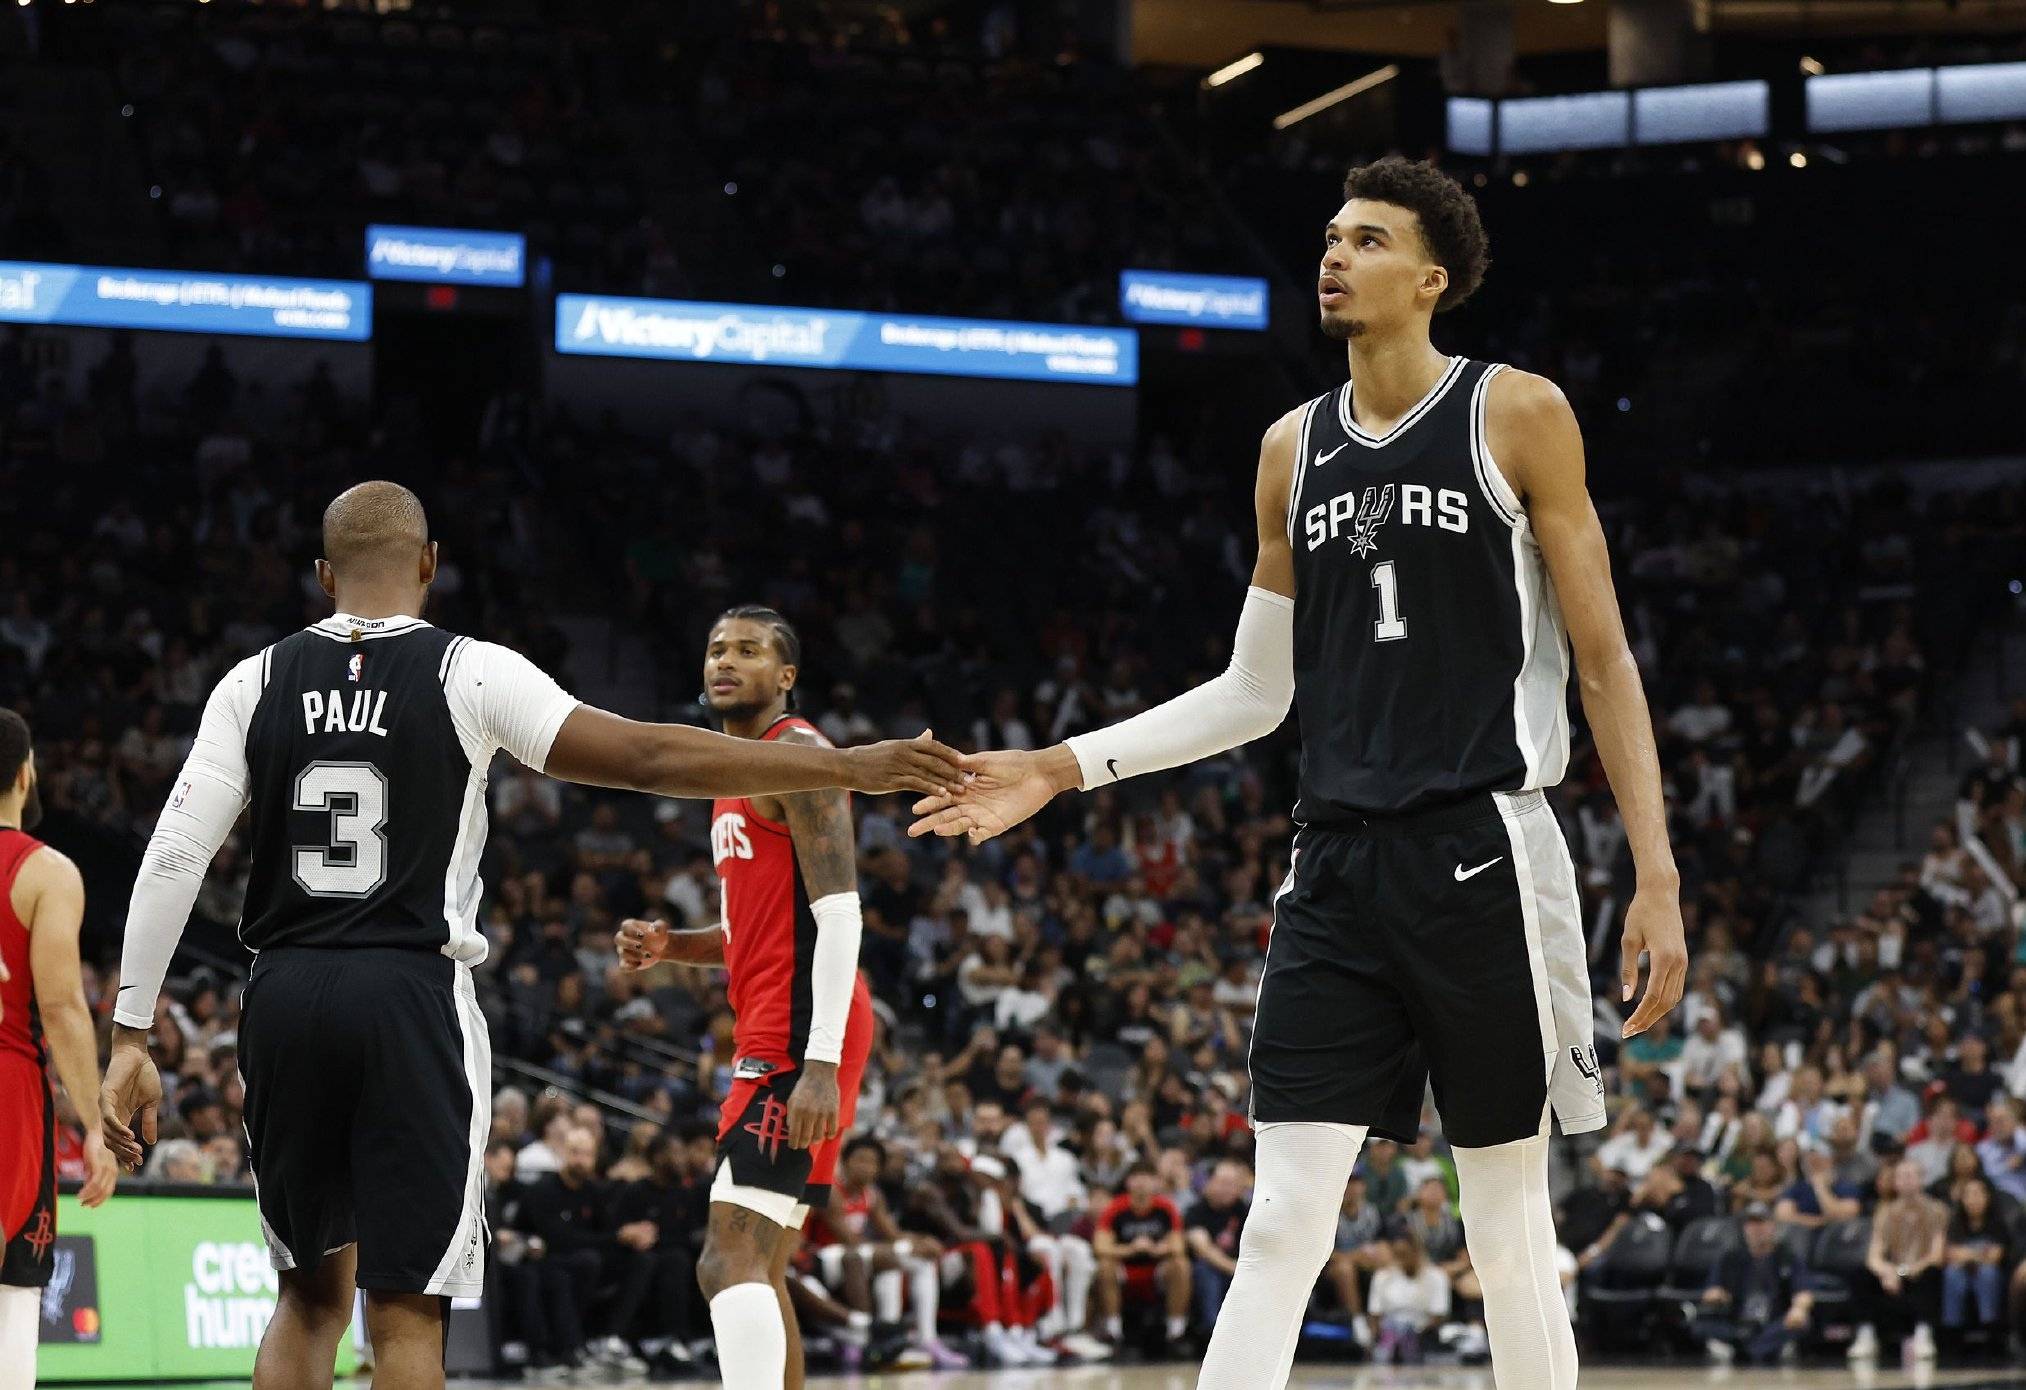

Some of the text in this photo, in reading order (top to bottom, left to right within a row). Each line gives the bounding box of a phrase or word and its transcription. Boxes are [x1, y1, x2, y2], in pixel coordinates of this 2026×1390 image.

[1370, 559, 1408, 643] 1
[302, 689, 388, 737] PAUL
[291, 760, 389, 900] 3
